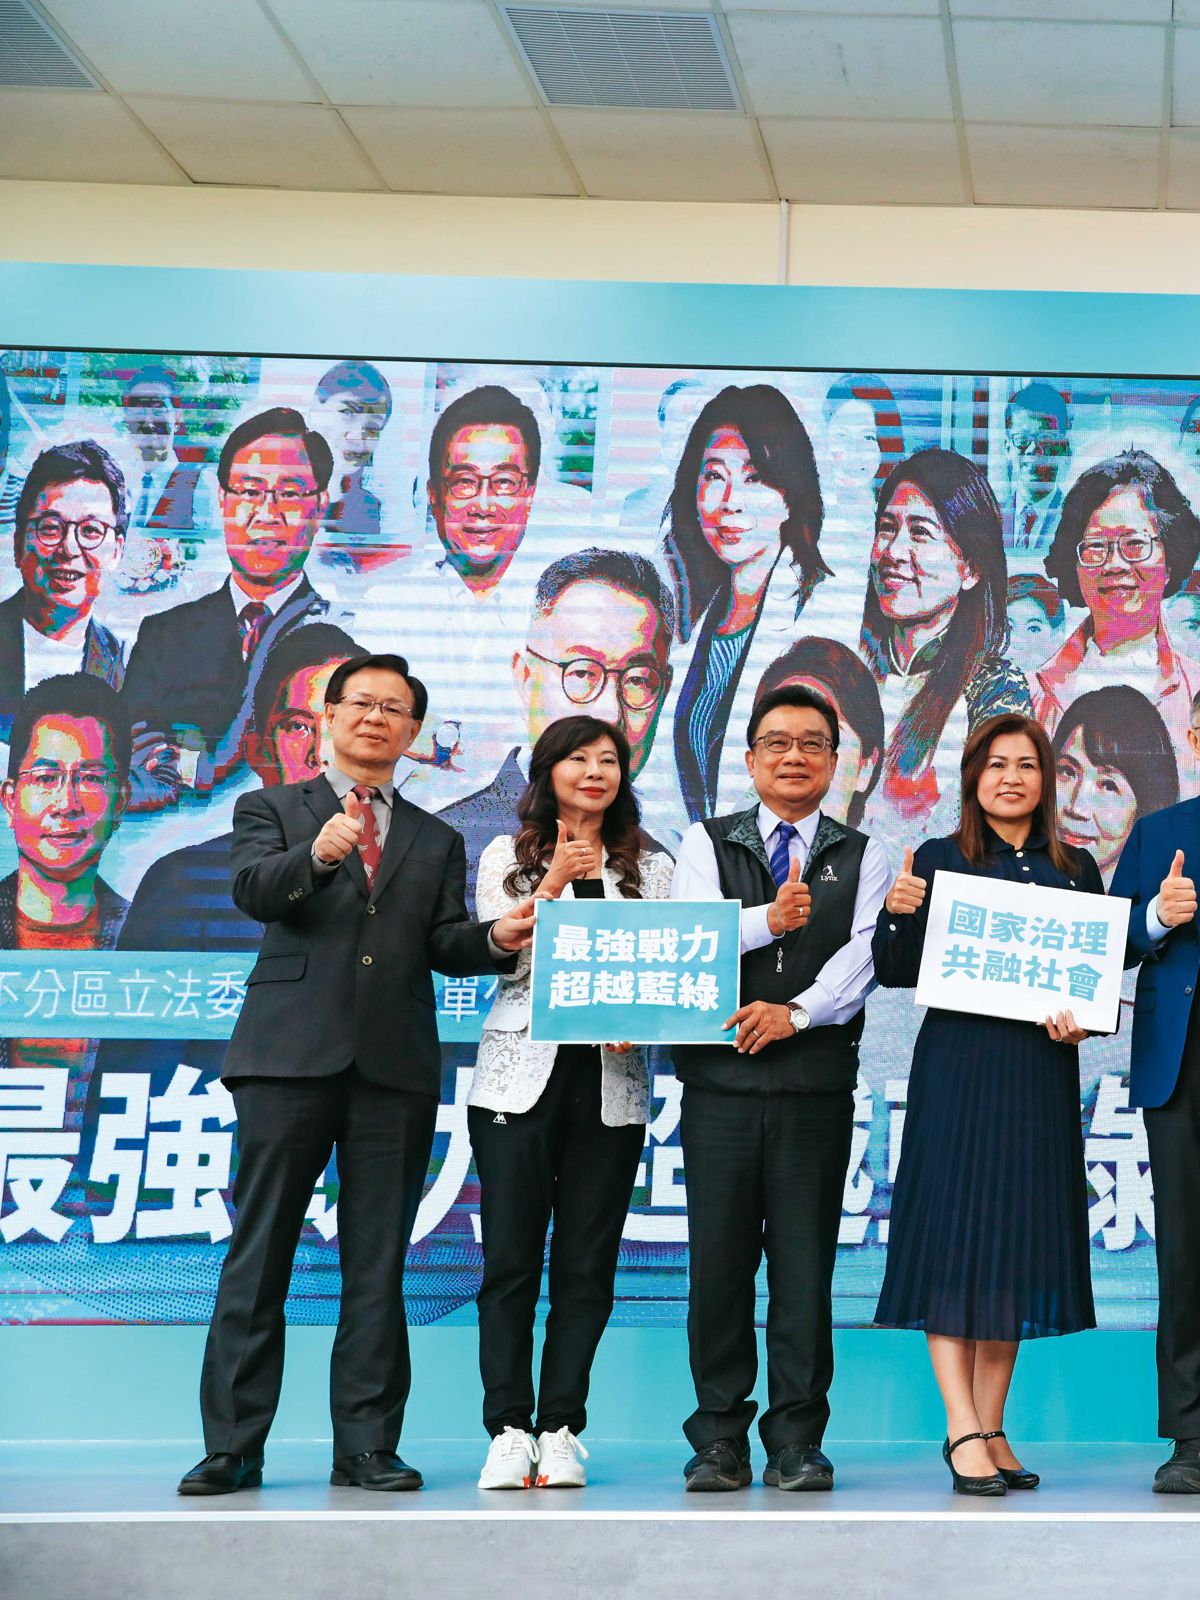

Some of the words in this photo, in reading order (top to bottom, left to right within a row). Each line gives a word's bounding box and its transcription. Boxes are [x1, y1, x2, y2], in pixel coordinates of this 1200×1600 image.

[552, 924, 719, 963] 最強戰力
[947, 899, 1110, 956] 國家治理
[548, 970, 720, 1011] 超越藍綠
[941, 944, 1104, 1002] 共融社會
